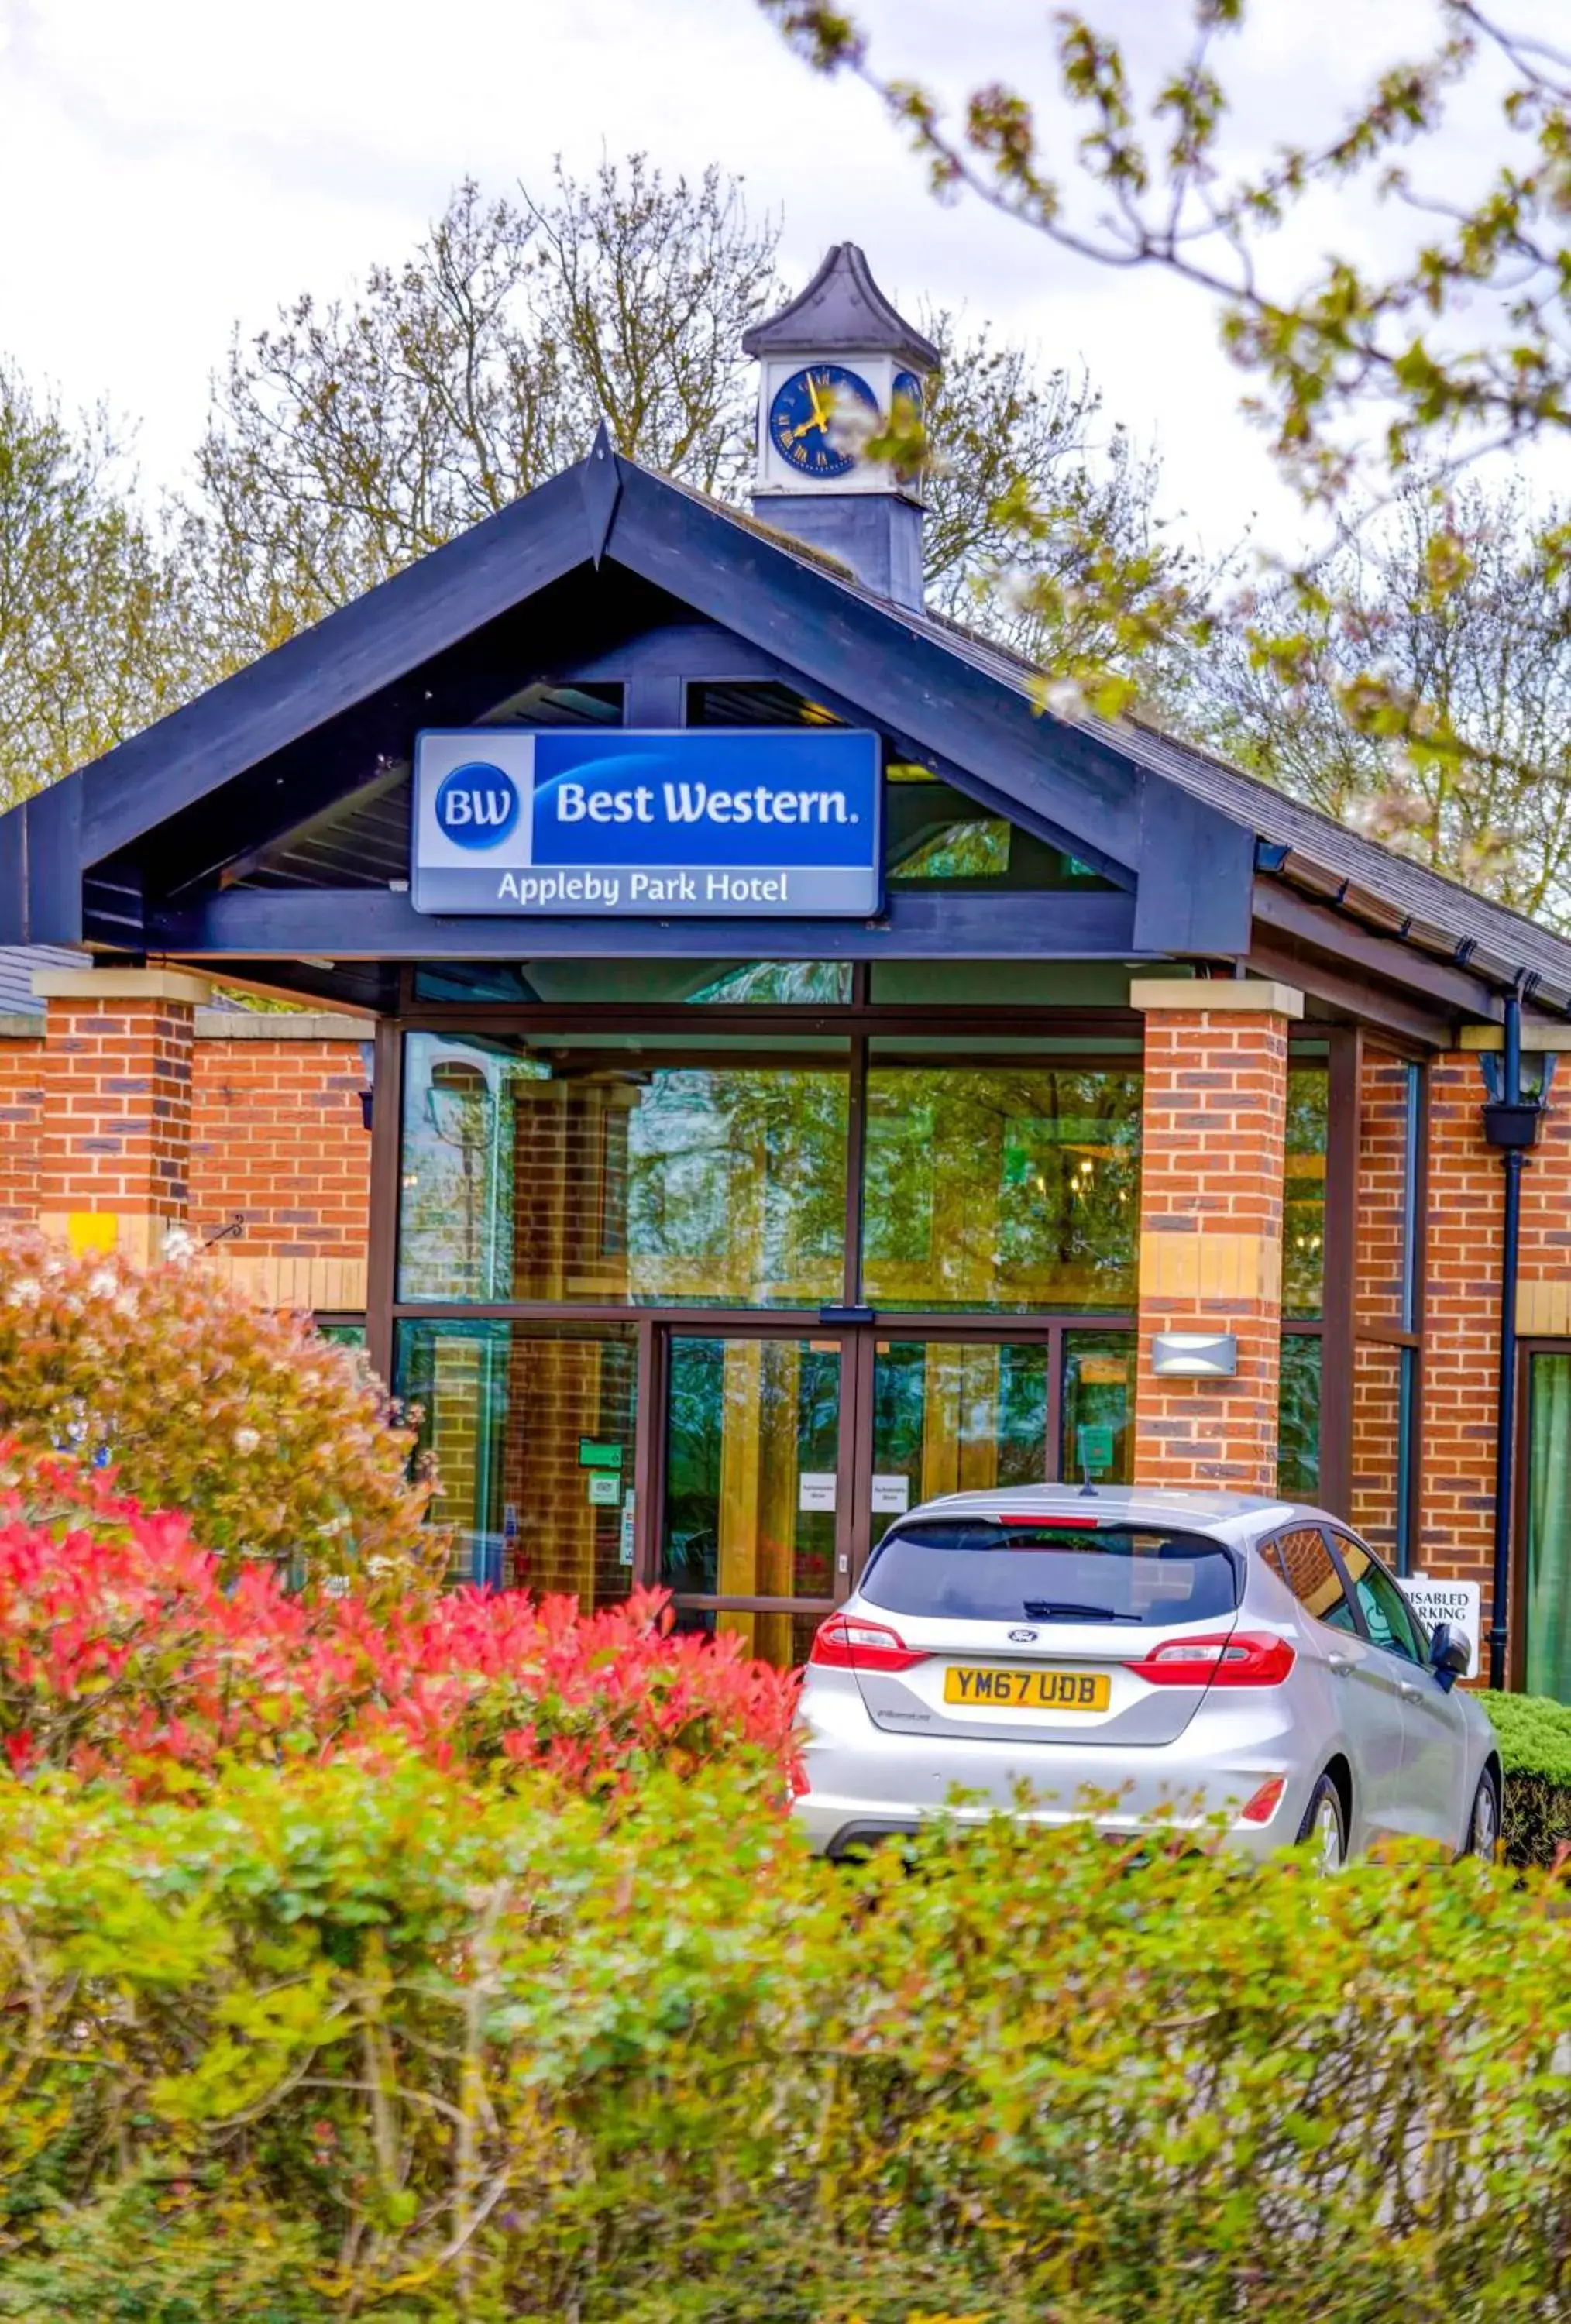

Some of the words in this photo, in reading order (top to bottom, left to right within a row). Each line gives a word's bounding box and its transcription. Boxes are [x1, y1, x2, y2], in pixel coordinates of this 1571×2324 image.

[445, 789, 511, 825] BW
[556, 782, 655, 823] Best
[497, 872, 620, 906] Appleby
[630, 871, 696, 901] Park
[706, 872, 788, 902] Hotel
[1418, 1607, 1466, 1621] RKING
[957, 1671, 1031, 1700] YM67
[1039, 1675, 1096, 1703] UDB
